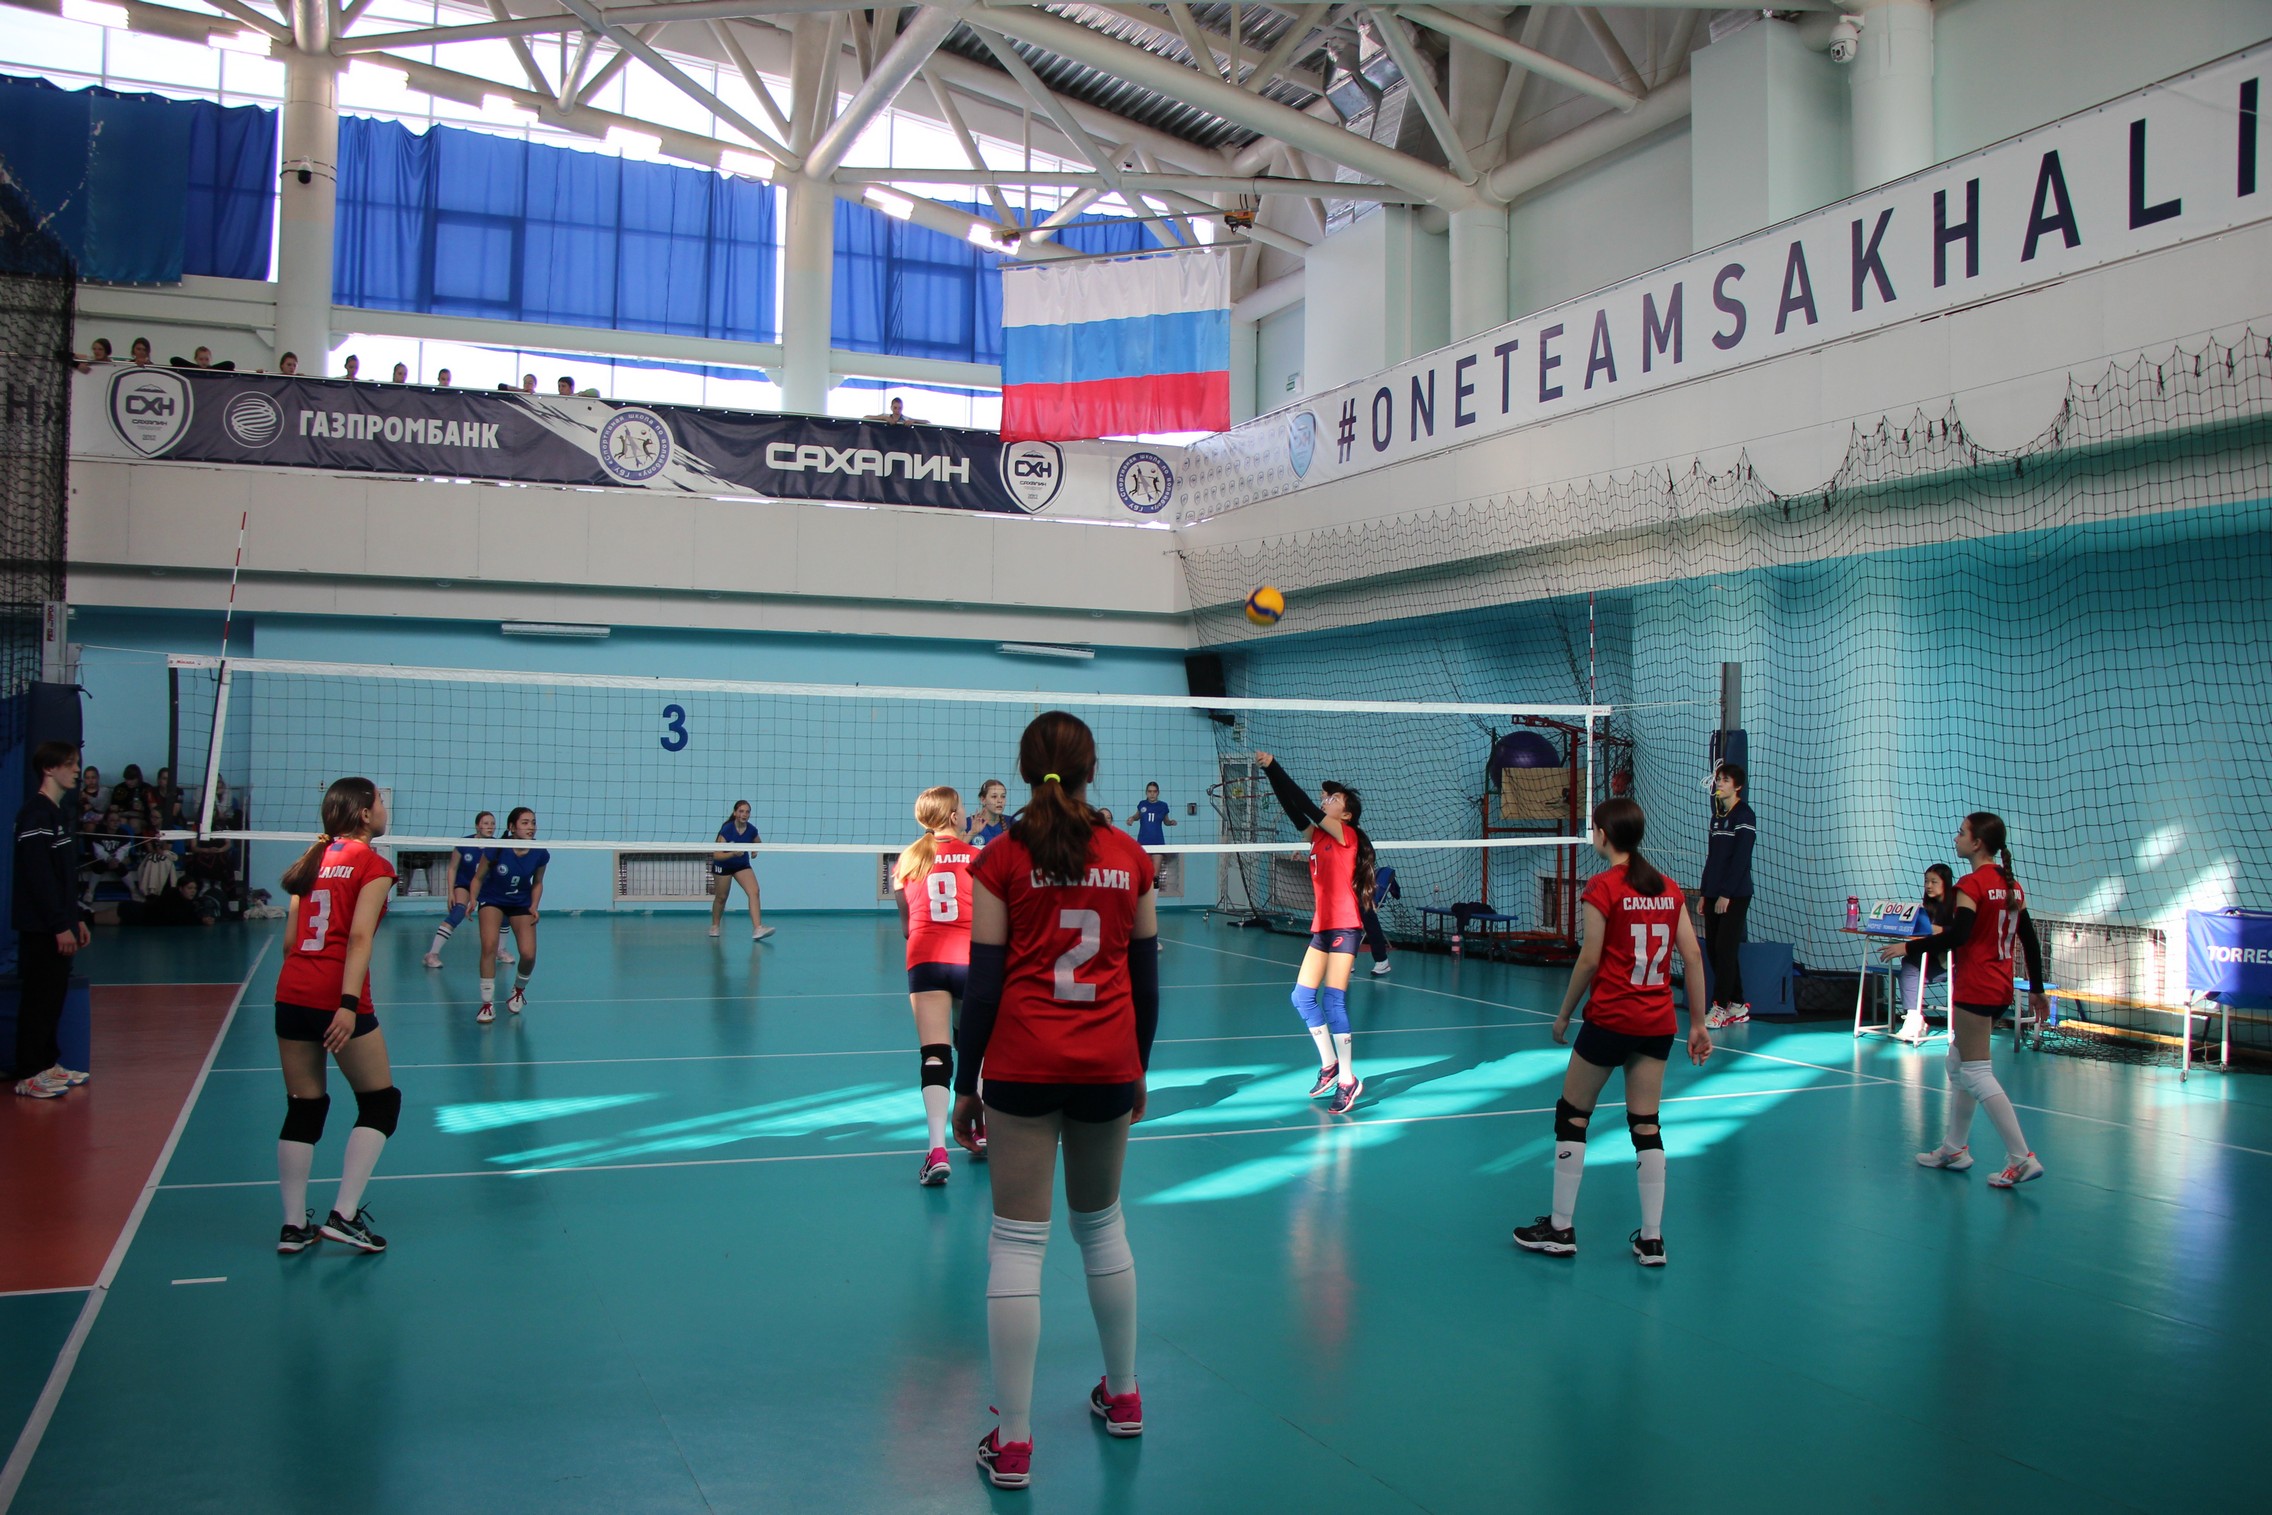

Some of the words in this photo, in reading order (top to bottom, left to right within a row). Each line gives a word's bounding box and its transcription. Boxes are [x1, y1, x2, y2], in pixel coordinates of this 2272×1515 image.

[126, 395, 175, 416] СХН
[299, 410, 500, 449] ГАЗПРОМБАНК
[627, 413, 654, 424] школа
[655, 425, 664, 435] по
[765, 442, 970, 484] САХАЛИН
[1014, 460, 1052, 478] СХН
[660, 704, 688, 752] 3
[1148, 812, 1155, 822] 11
[511, 875, 520, 887] 9
[927, 872, 959, 922] 8
[1622, 896, 1675, 911] САХАЛИН
[1872, 903, 1883, 918] 4
[1885, 904, 1893, 913] 0
[1894, 904, 1903, 914] 0
[1903, 905, 1914, 919] 4
[301, 889, 331, 951] 3
[1054, 909, 1101, 1002] 2
[1630, 923, 1670, 986] 12
